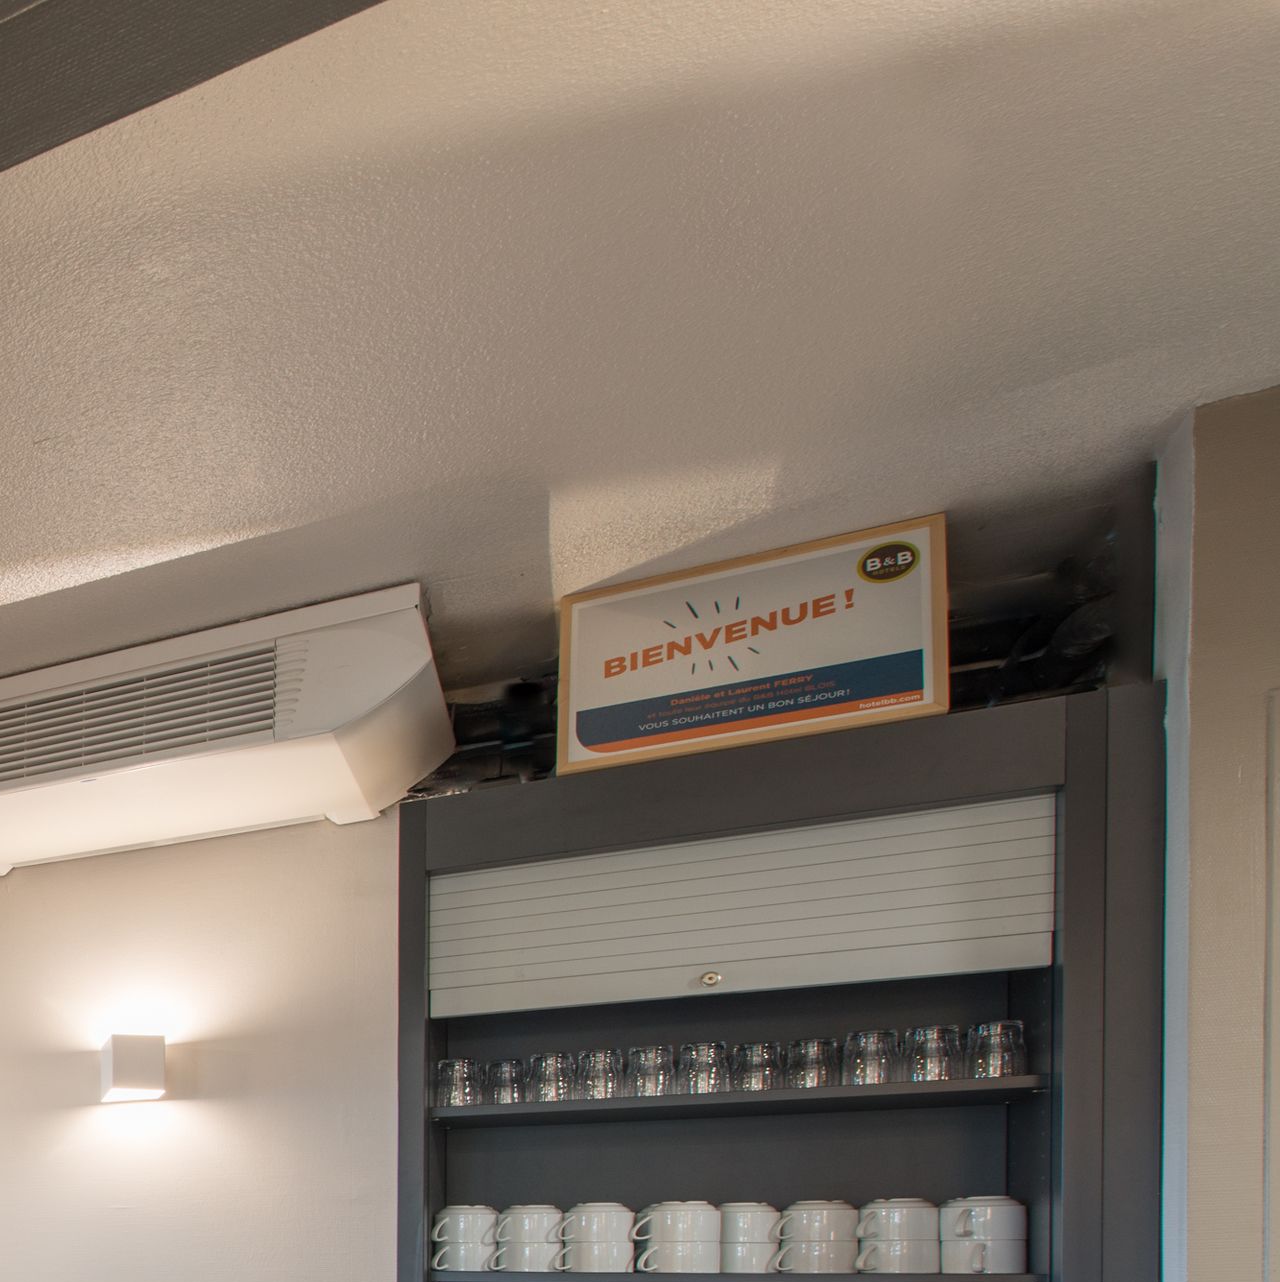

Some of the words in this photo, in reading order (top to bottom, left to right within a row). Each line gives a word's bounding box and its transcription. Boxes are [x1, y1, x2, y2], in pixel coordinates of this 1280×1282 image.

[865, 551, 913, 572] B&B
[713, 688, 727, 698] et
[728, 682, 772, 696] Laurent
[774, 674, 814, 689] FERRY
[859, 693, 921, 710] hotelbb.com
[638, 719, 669, 731] VOUS
[671, 707, 744, 726] SOUHAITENT
[747, 703, 766, 713] UN
[768, 698, 795, 711] BON
